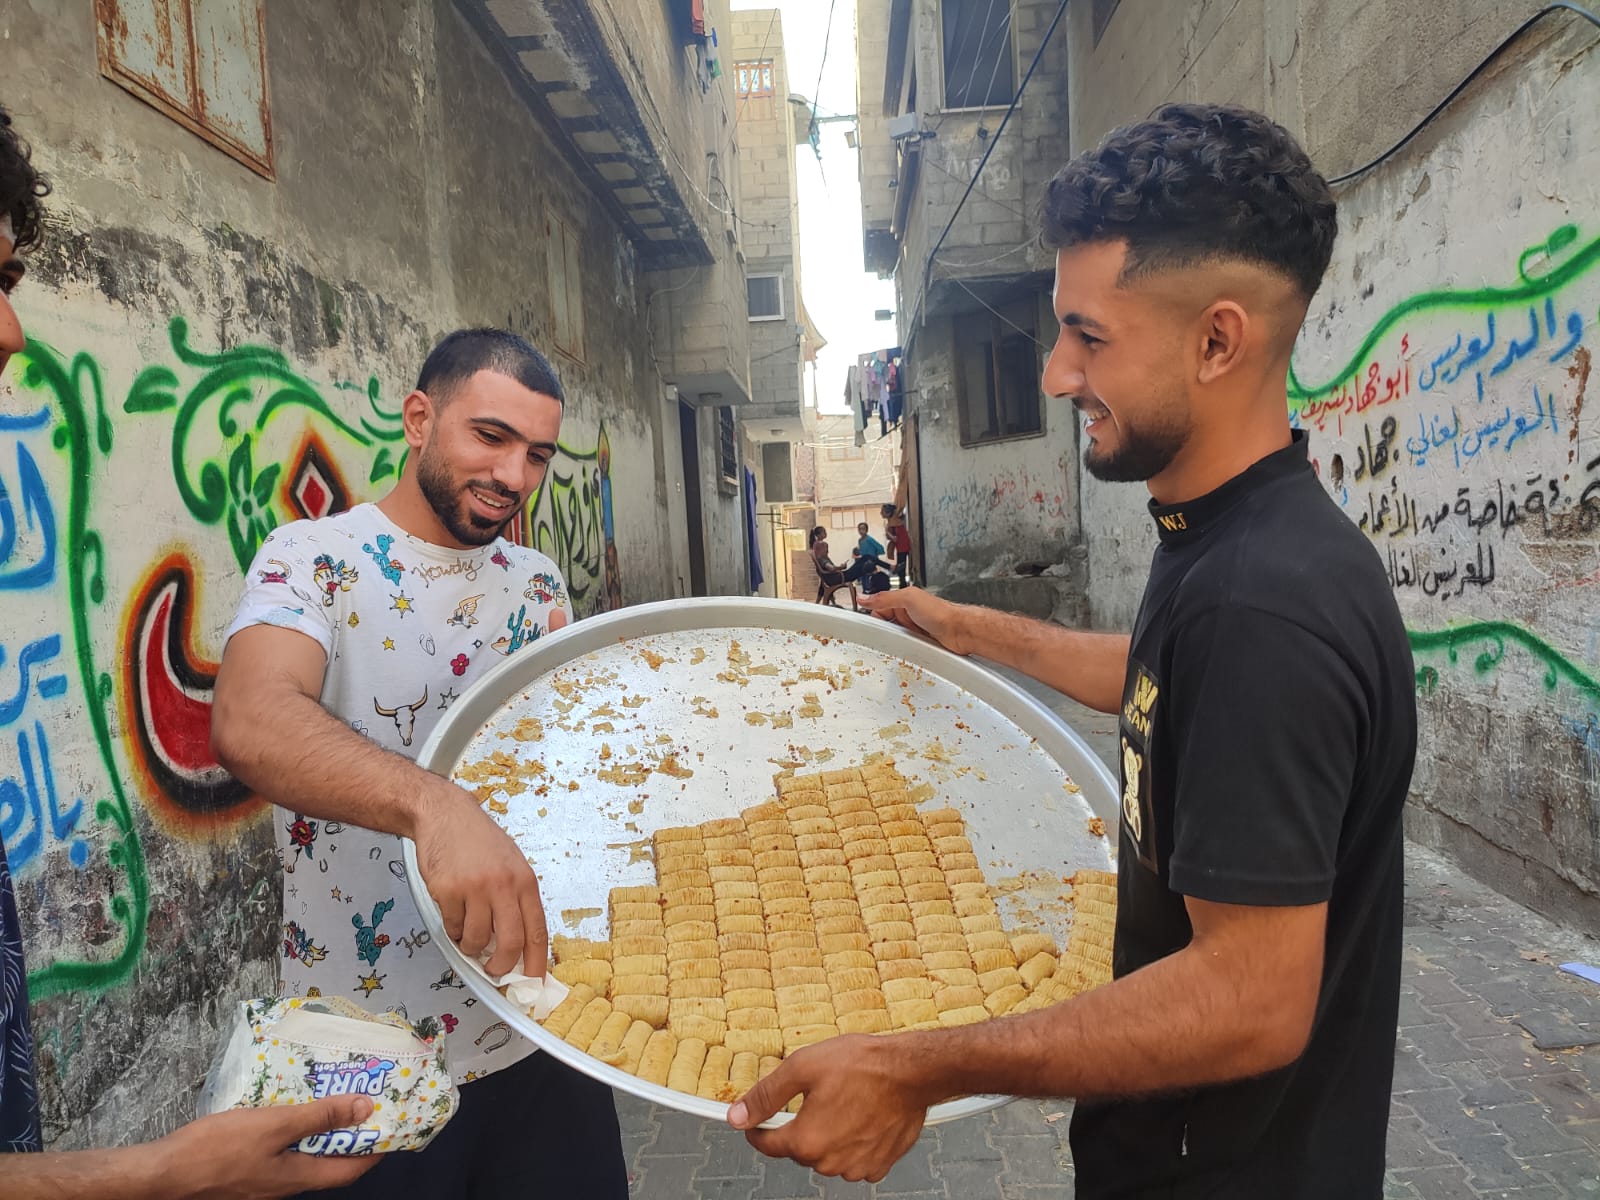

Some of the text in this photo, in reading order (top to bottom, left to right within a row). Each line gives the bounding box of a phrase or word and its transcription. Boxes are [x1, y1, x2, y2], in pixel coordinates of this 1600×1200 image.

[1462, 383, 1558, 456] العريس
[1406, 405, 1460, 469] الغالي
[411, 557, 484, 589] Howdy
[1387, 543, 1421, 588] الغال
[314, 1060, 367, 1072] Super Soft
[314, 1069, 385, 1098] PURE
[298, 1130, 380, 1155] URE
